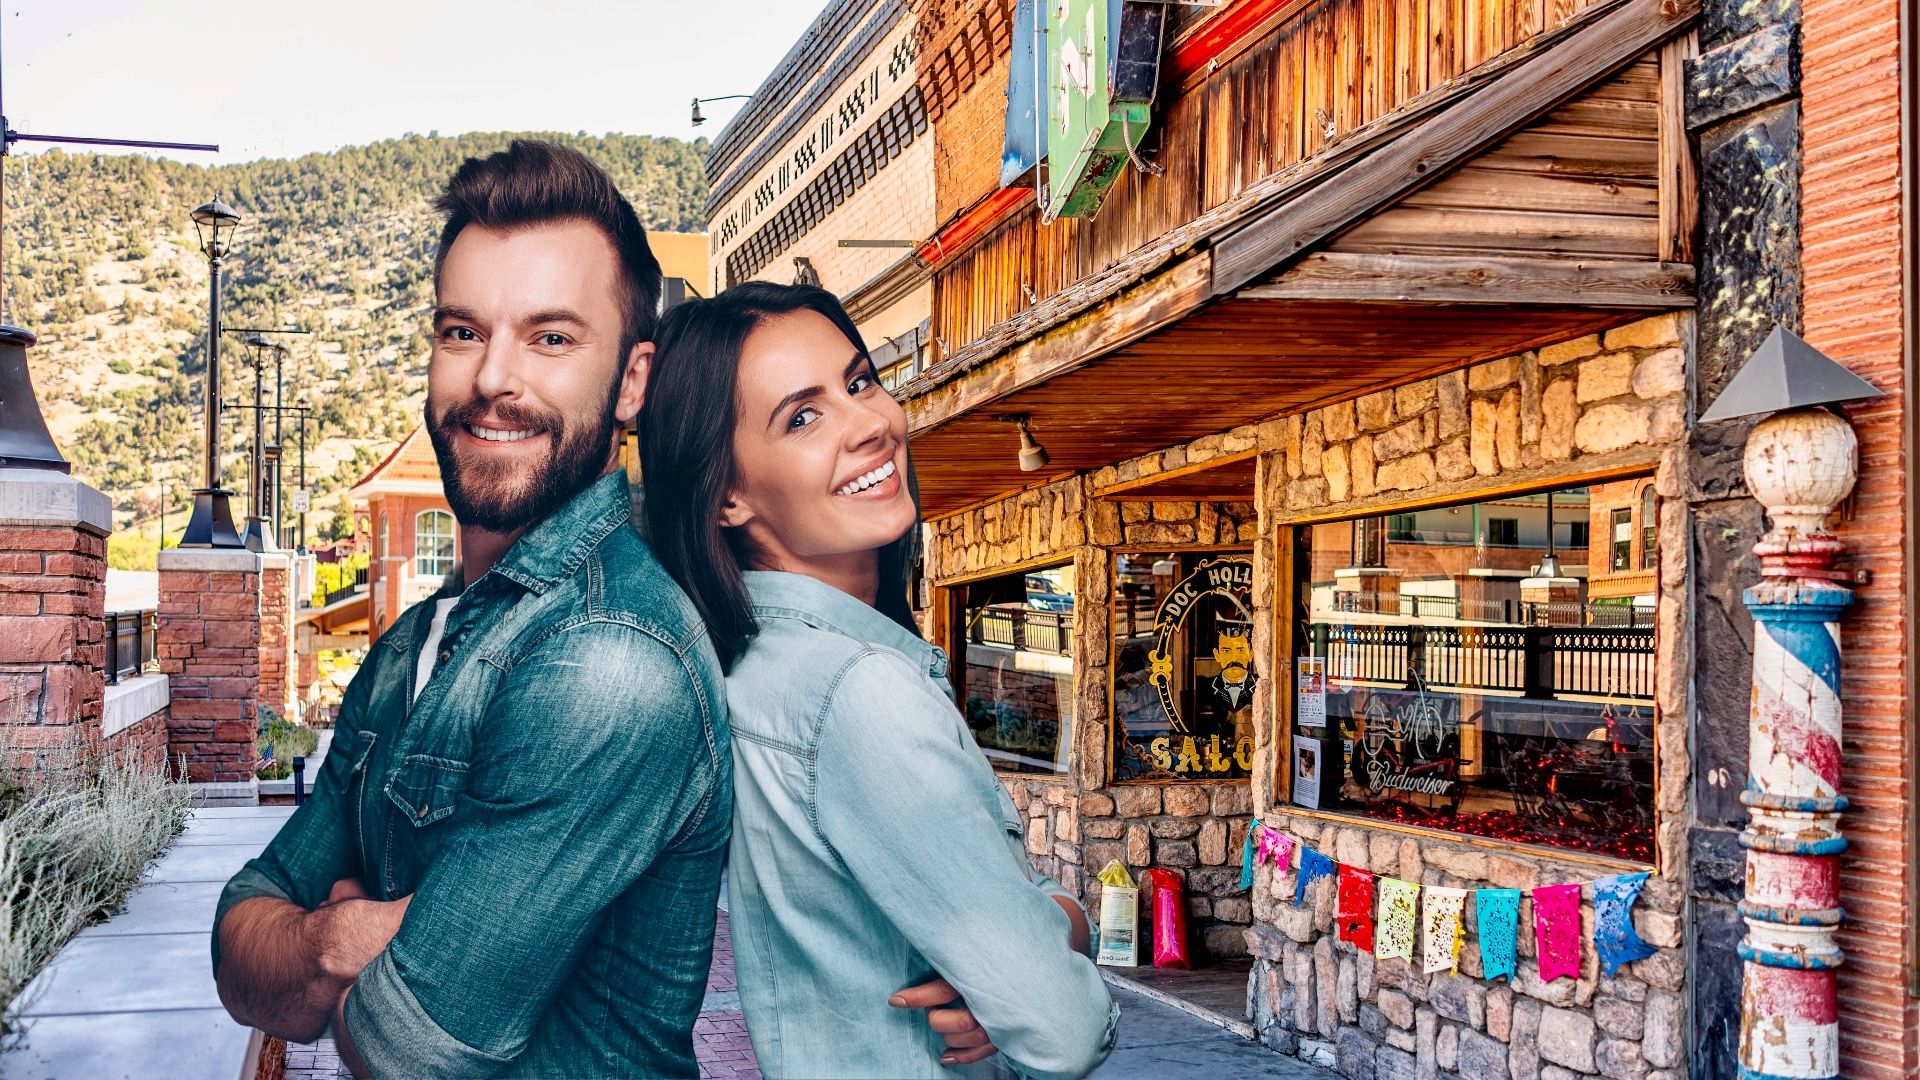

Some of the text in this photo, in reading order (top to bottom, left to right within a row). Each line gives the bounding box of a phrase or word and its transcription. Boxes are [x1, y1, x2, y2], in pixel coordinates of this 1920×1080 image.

[1165, 566, 1252, 617] DOC HOLL
[1150, 734, 1256, 773] SALO
[1366, 759, 1455, 795] Budweiser
